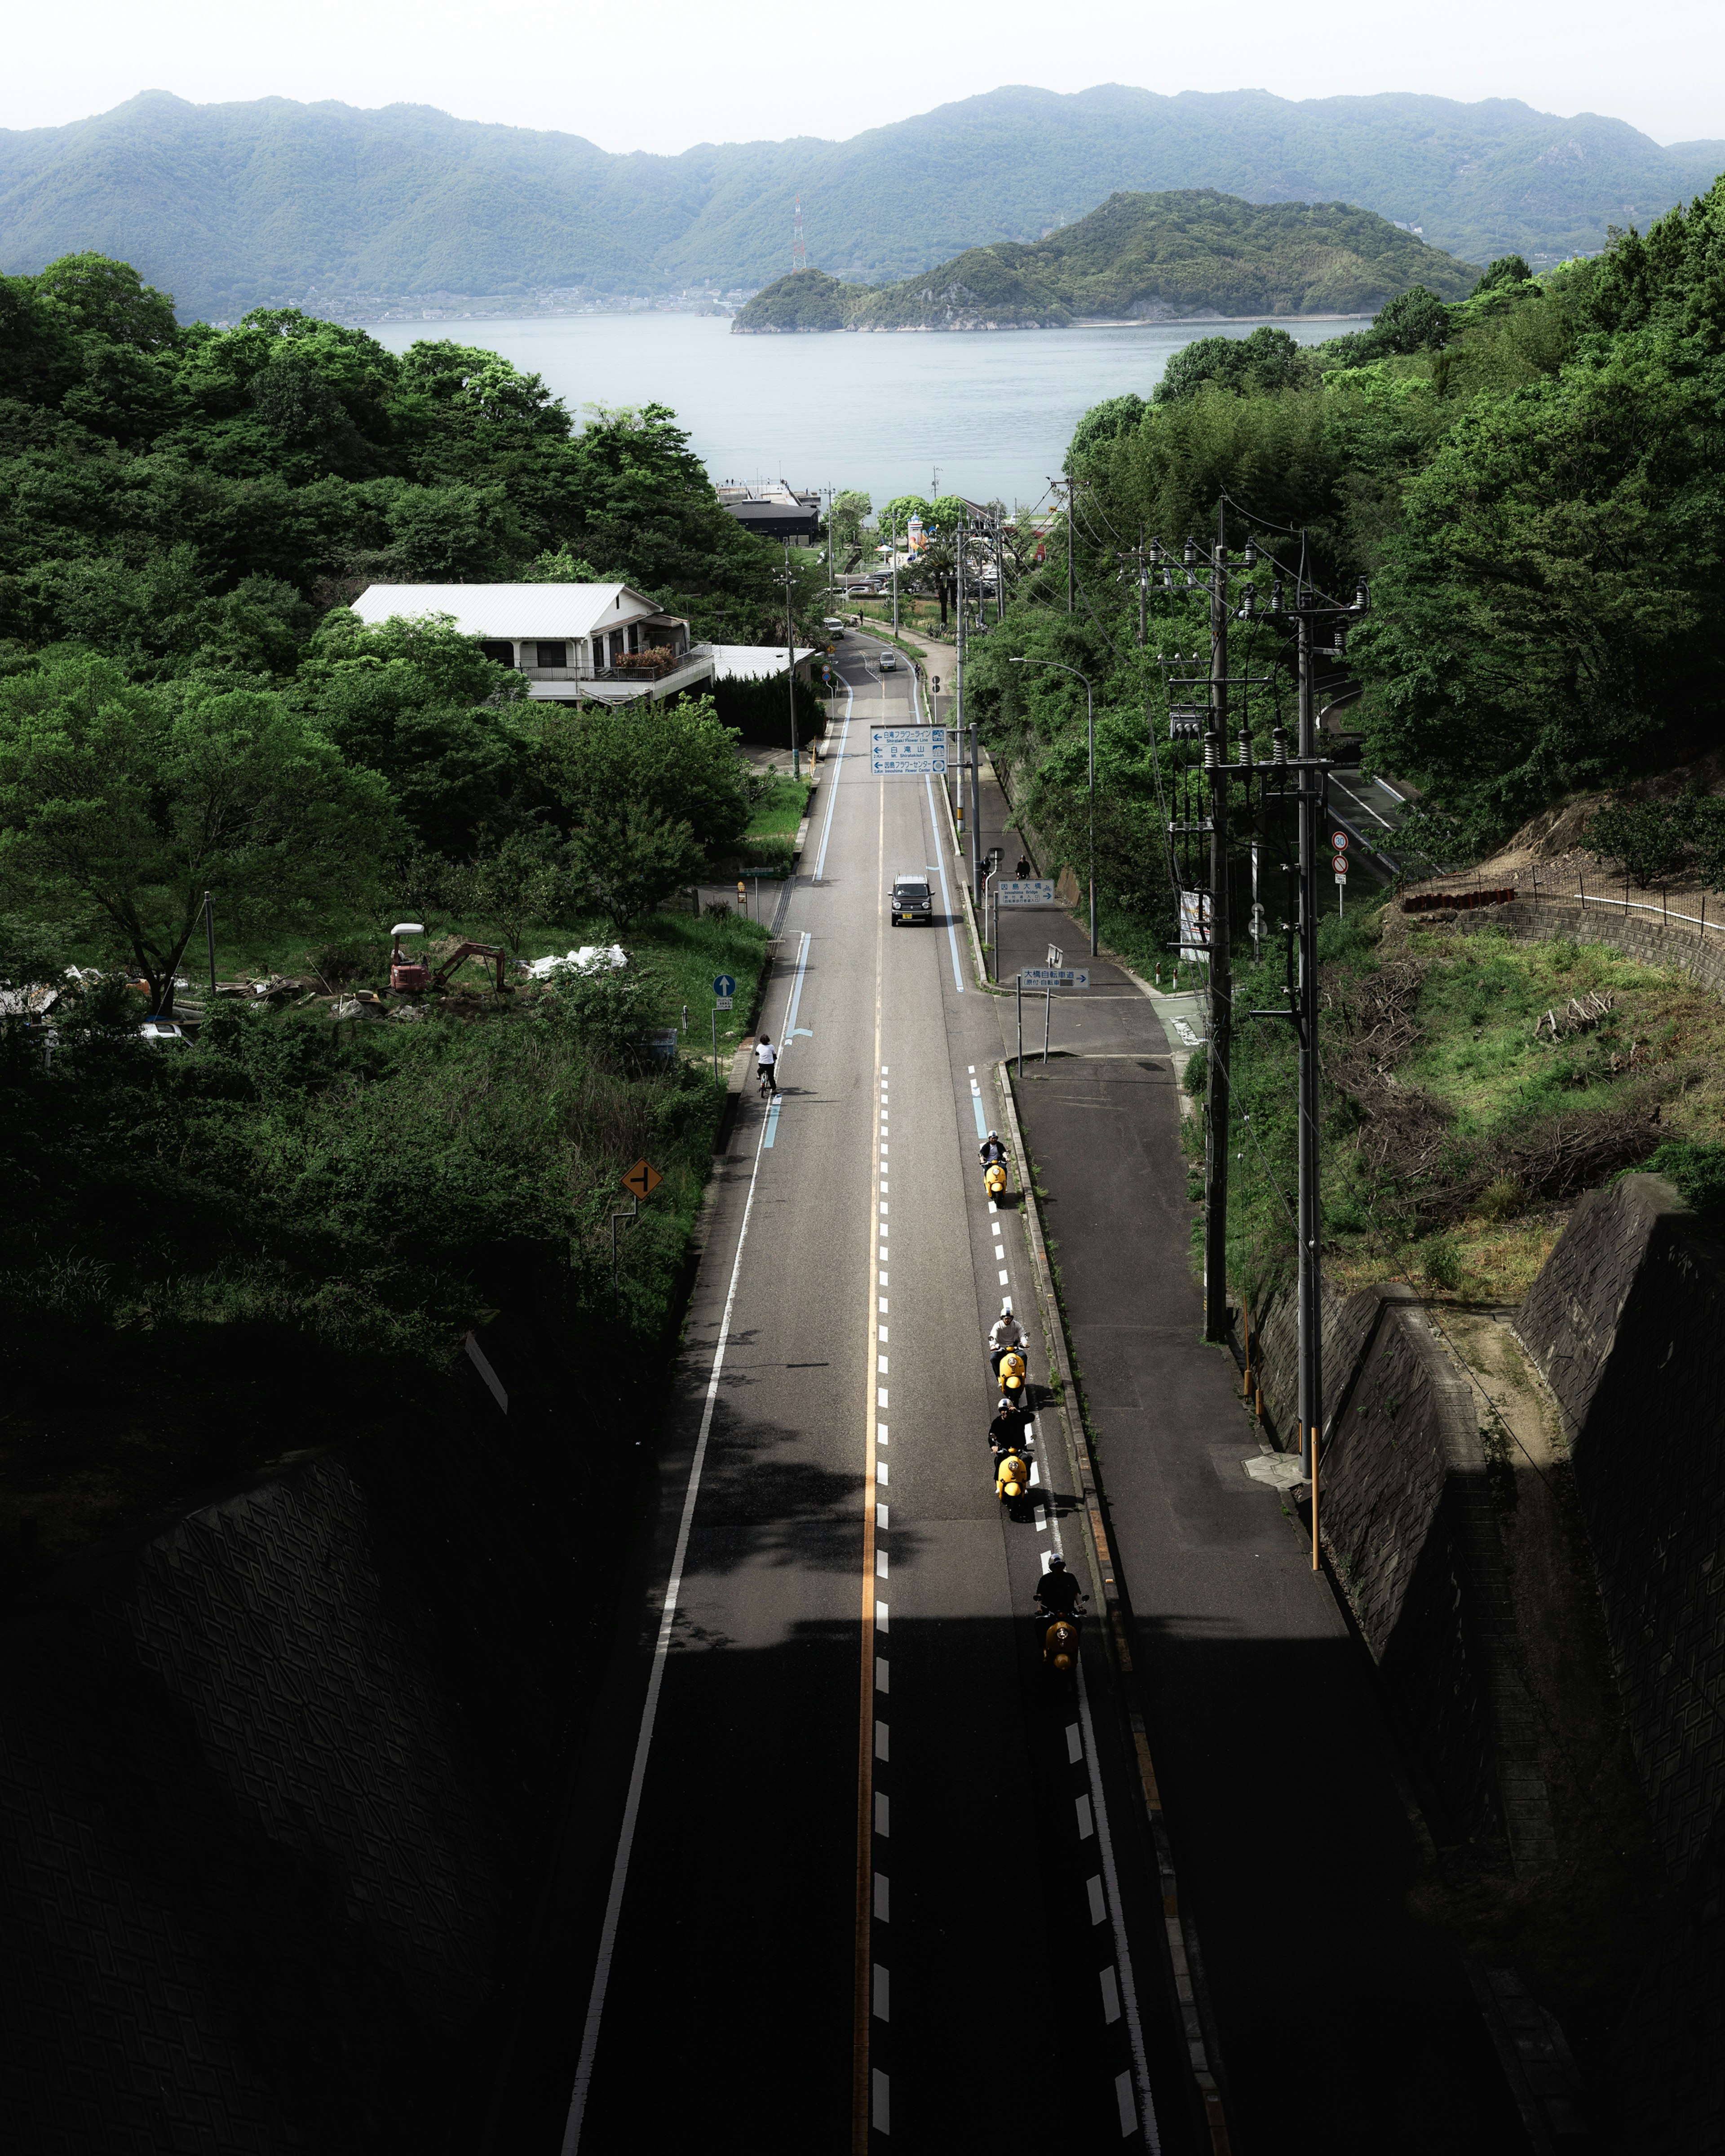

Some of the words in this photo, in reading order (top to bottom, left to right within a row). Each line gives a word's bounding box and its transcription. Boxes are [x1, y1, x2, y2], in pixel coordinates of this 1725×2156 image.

[1336, 837, 1345, 846] 30
[1024, 970, 1074, 978] 大橋自転車道
